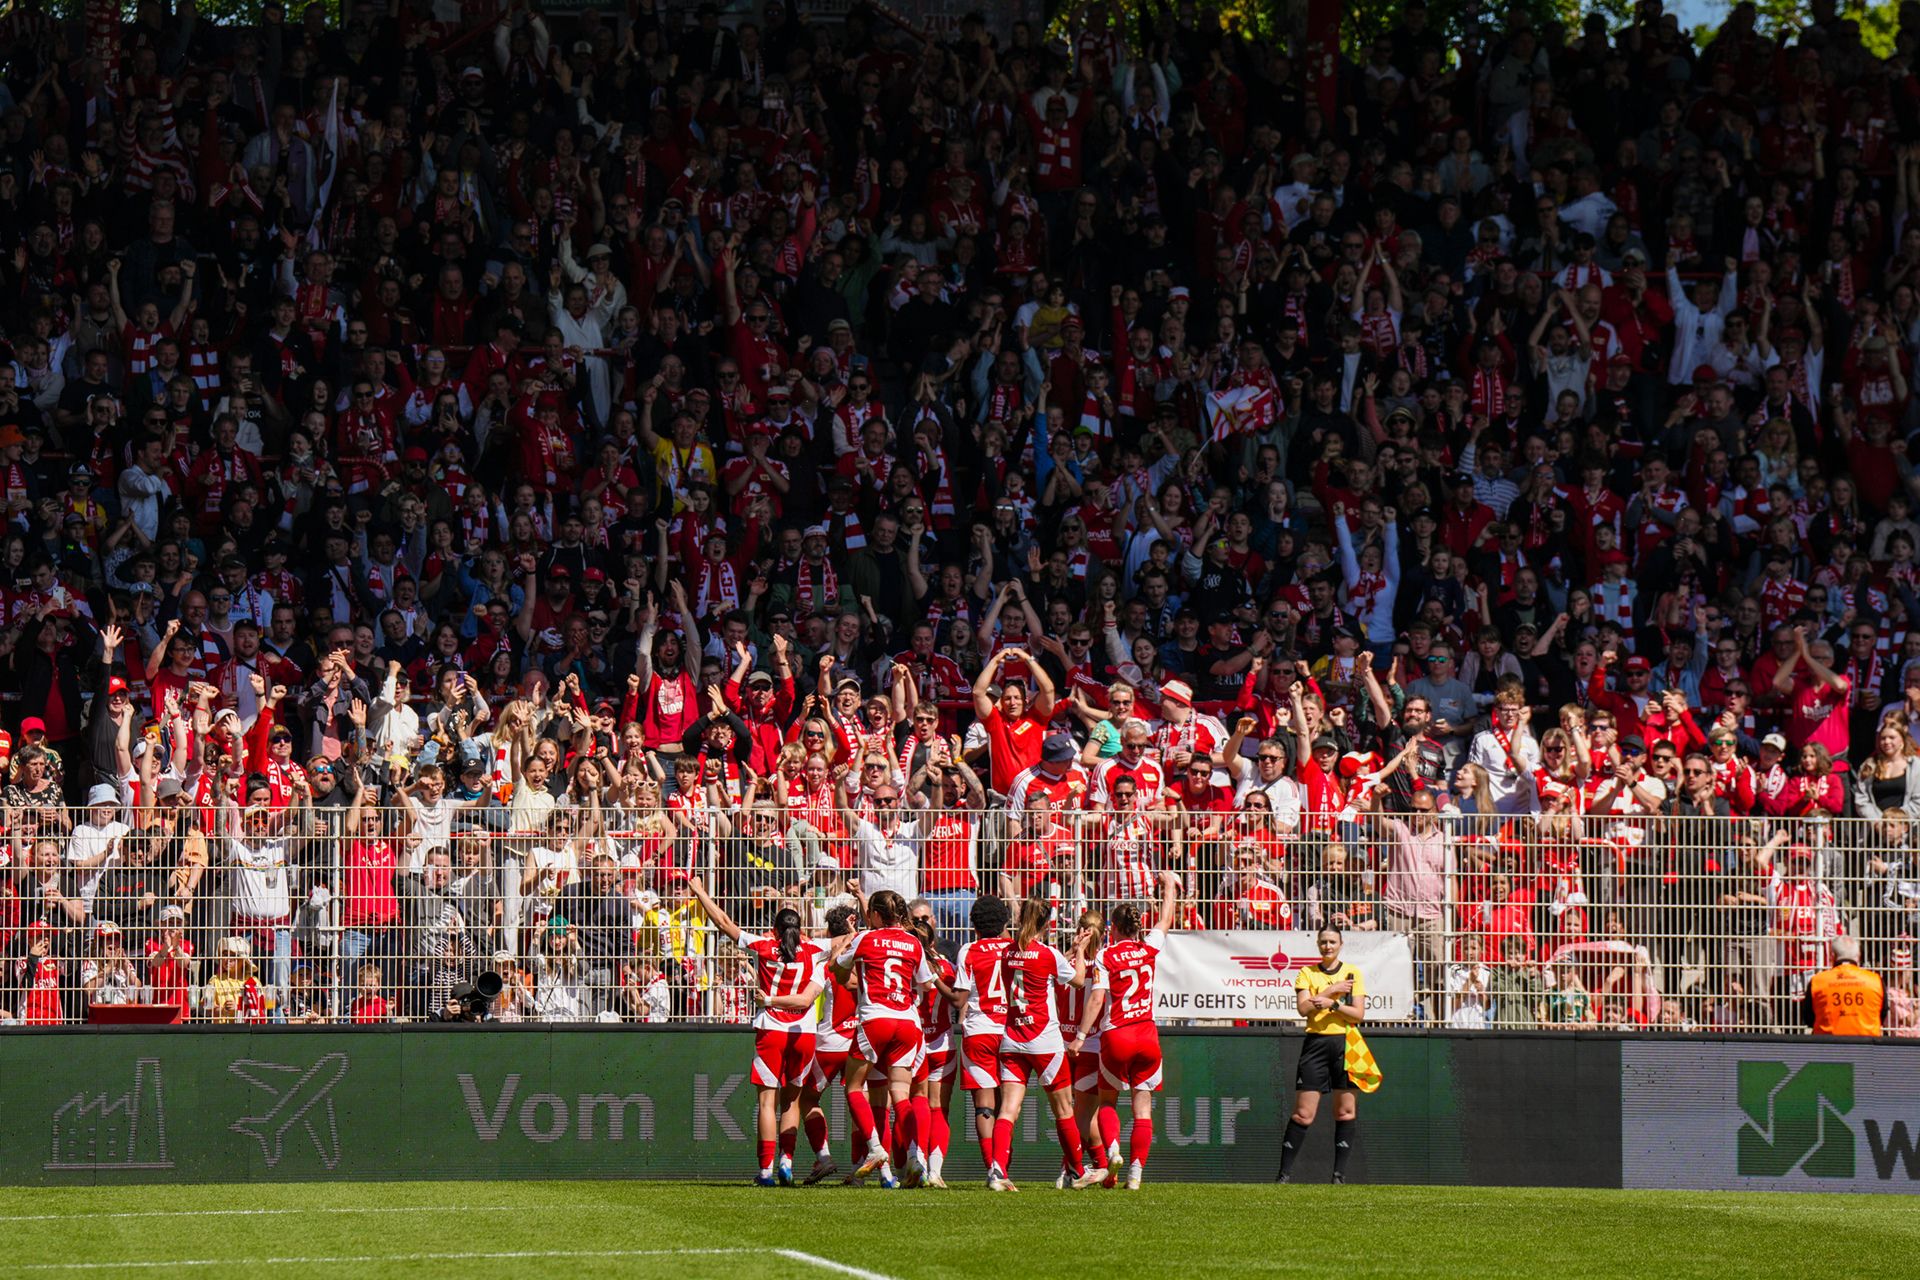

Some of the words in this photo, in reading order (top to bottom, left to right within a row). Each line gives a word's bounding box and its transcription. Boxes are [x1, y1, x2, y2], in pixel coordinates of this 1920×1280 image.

[931, 822, 964, 838] BERLIN
[881, 940, 891, 948] FC
[892, 941, 914, 952] UNION
[1016, 950, 1040, 960] UNION
[1120, 951, 1131, 961] FC
[766, 961, 805, 997] 77
[883, 958, 903, 993] 6
[988, 959, 1007, 1005] 4
[1221, 977, 1292, 988] VIKTORIA
[1120, 964, 1154, 1012] 23
[1158, 993, 1189, 1008] AUF
[1194, 994, 1246, 1009] GEHTS
[1831, 991, 1864, 1007] 366
[456, 1073, 656, 1143] Vom
